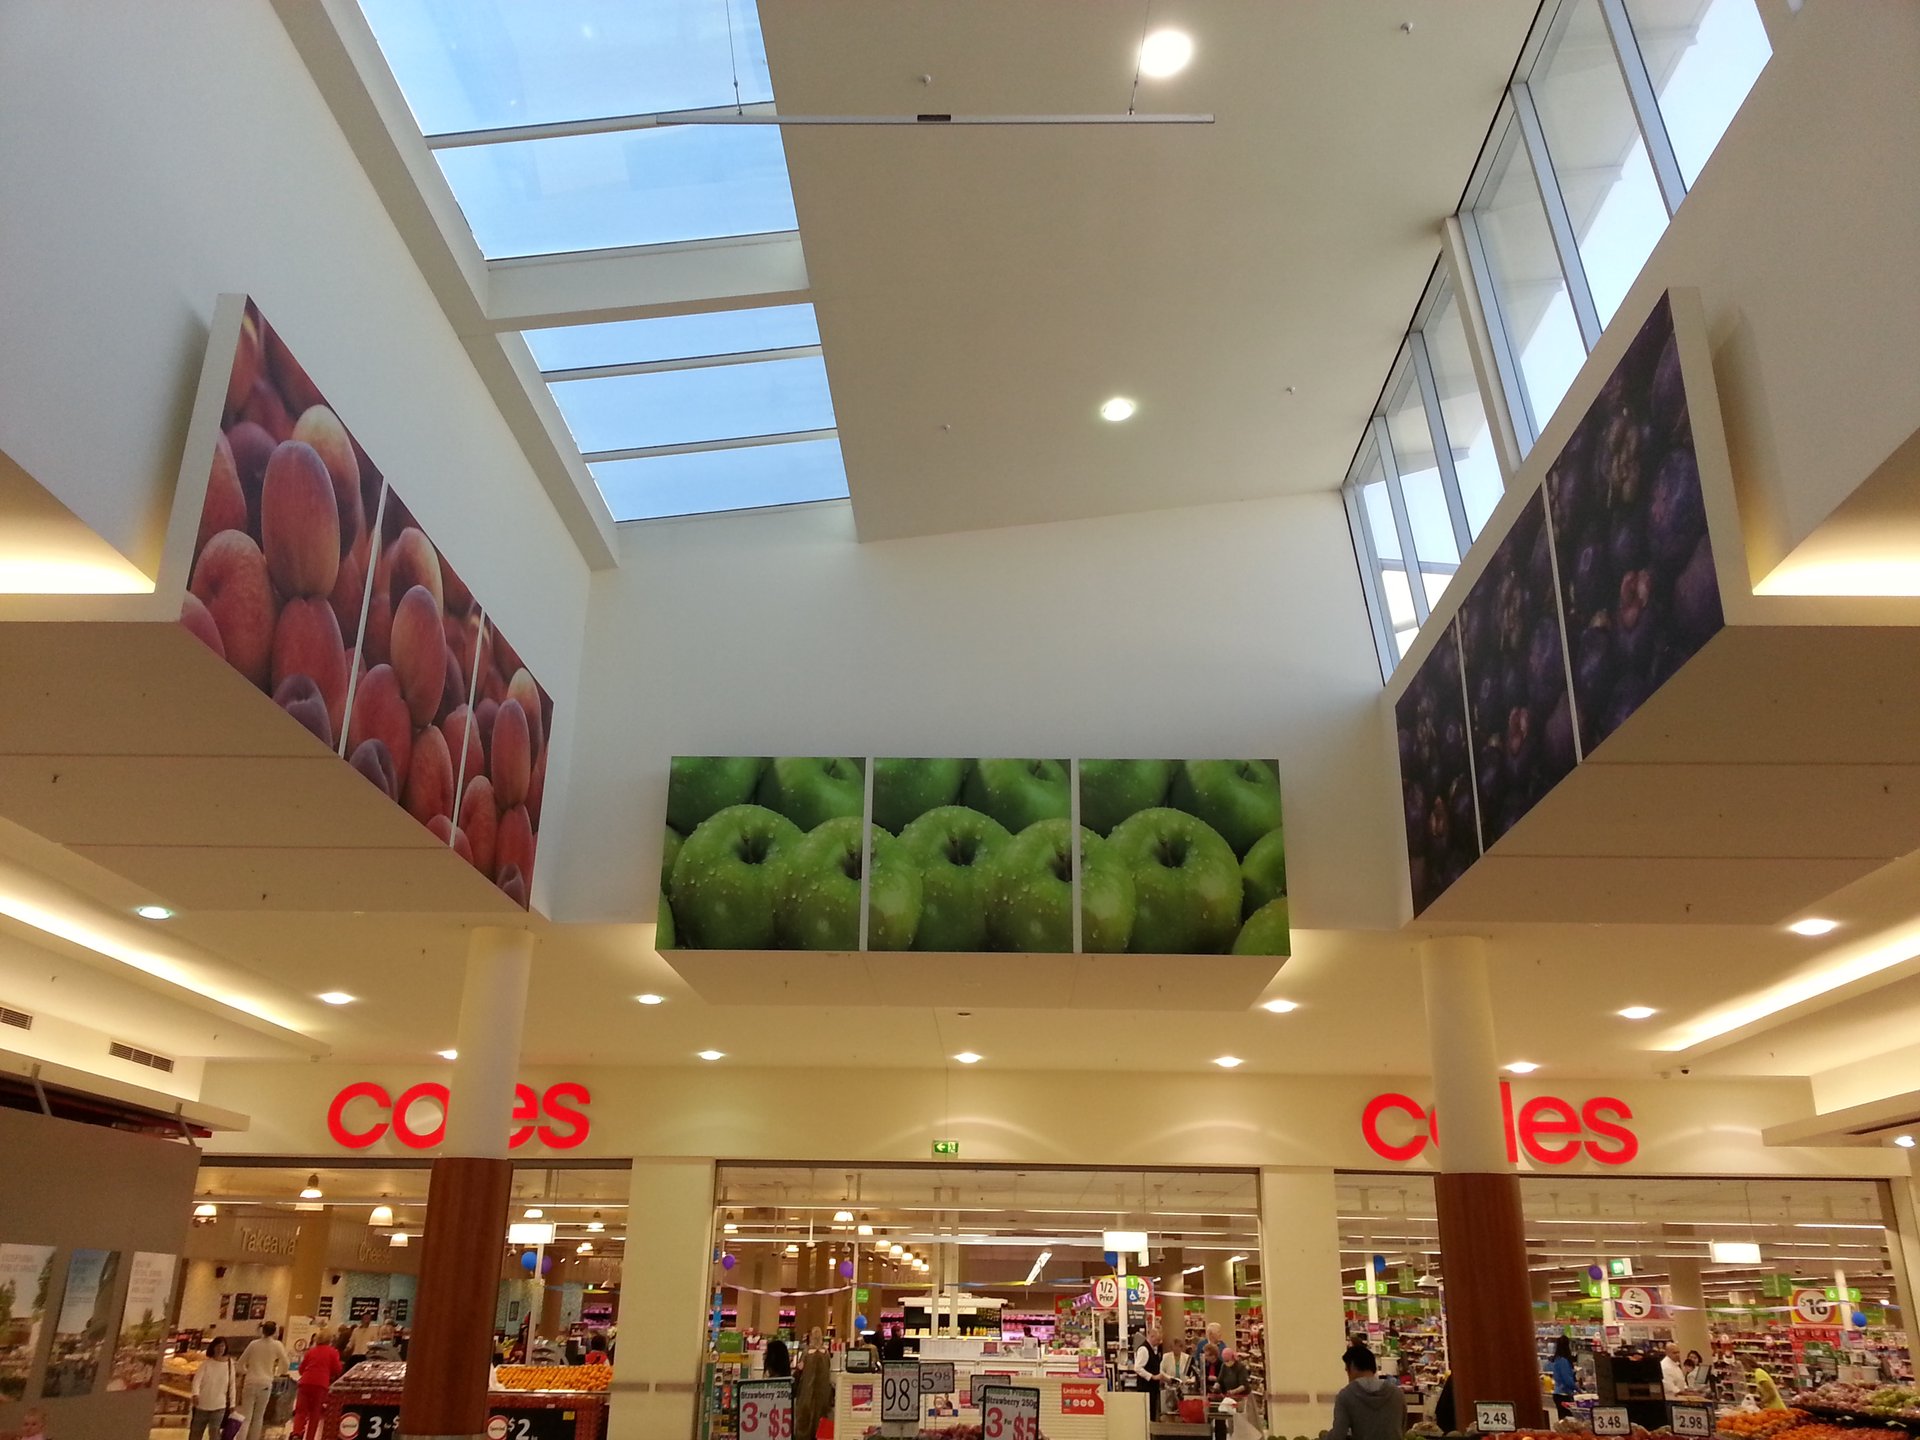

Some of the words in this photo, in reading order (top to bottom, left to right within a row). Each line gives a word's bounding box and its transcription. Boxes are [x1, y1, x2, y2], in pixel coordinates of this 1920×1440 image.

[1362, 1081, 1638, 1164] cles
[1100, 1281, 1113, 1294] 1/2
[1130, 1278, 1135, 1287] 1
[1611, 1286, 1617, 1294] 5
[1828, 1290, 1836, 1298] 6
[1849, 1290, 1856, 1298] 7
[1099, 1294, 1113, 1302] Price
[741, 1391, 775, 1400] Strawberry
[985, 1396, 1020, 1408] Strawberry
[741, 1402, 759, 1432] 3
[768, 1404, 792, 1440] $5
[986, 1407, 1003, 1438] 3
[1013, 1411, 1037, 1440] $5
[367, 1416, 382, 1438] 3
